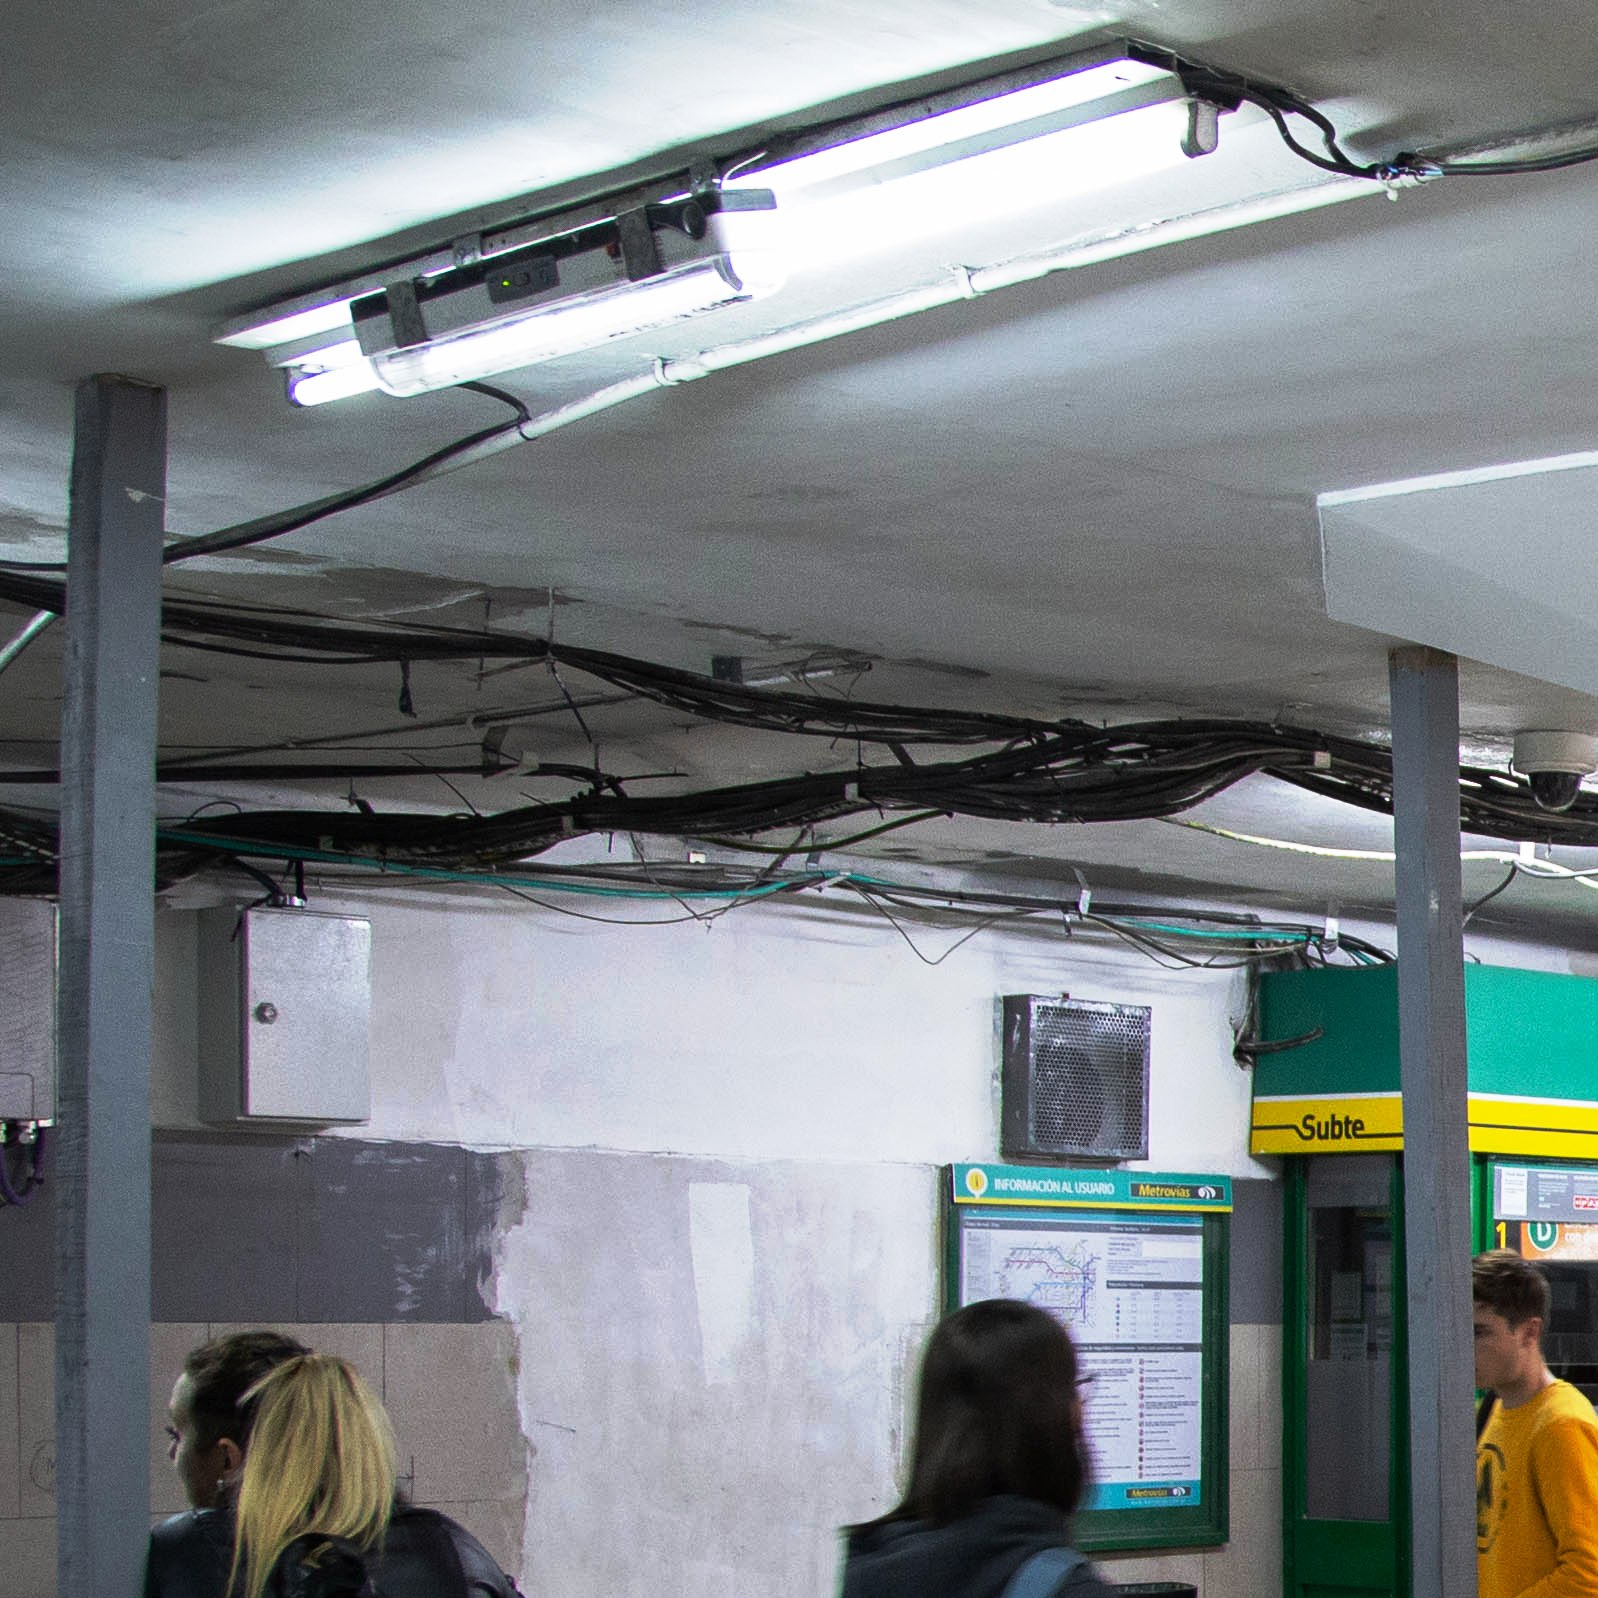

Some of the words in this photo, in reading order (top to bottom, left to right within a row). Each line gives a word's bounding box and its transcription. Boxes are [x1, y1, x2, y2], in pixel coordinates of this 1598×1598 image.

[1302, 1113, 1364, 1141] Subte
[994, 1178, 1060, 1193] INFORMACIÓN
[1061, 1182, 1073, 1193] AL
[1074, 1182, 1115, 1195] USUARIO
[1496, 1222, 1506, 1249] 1
